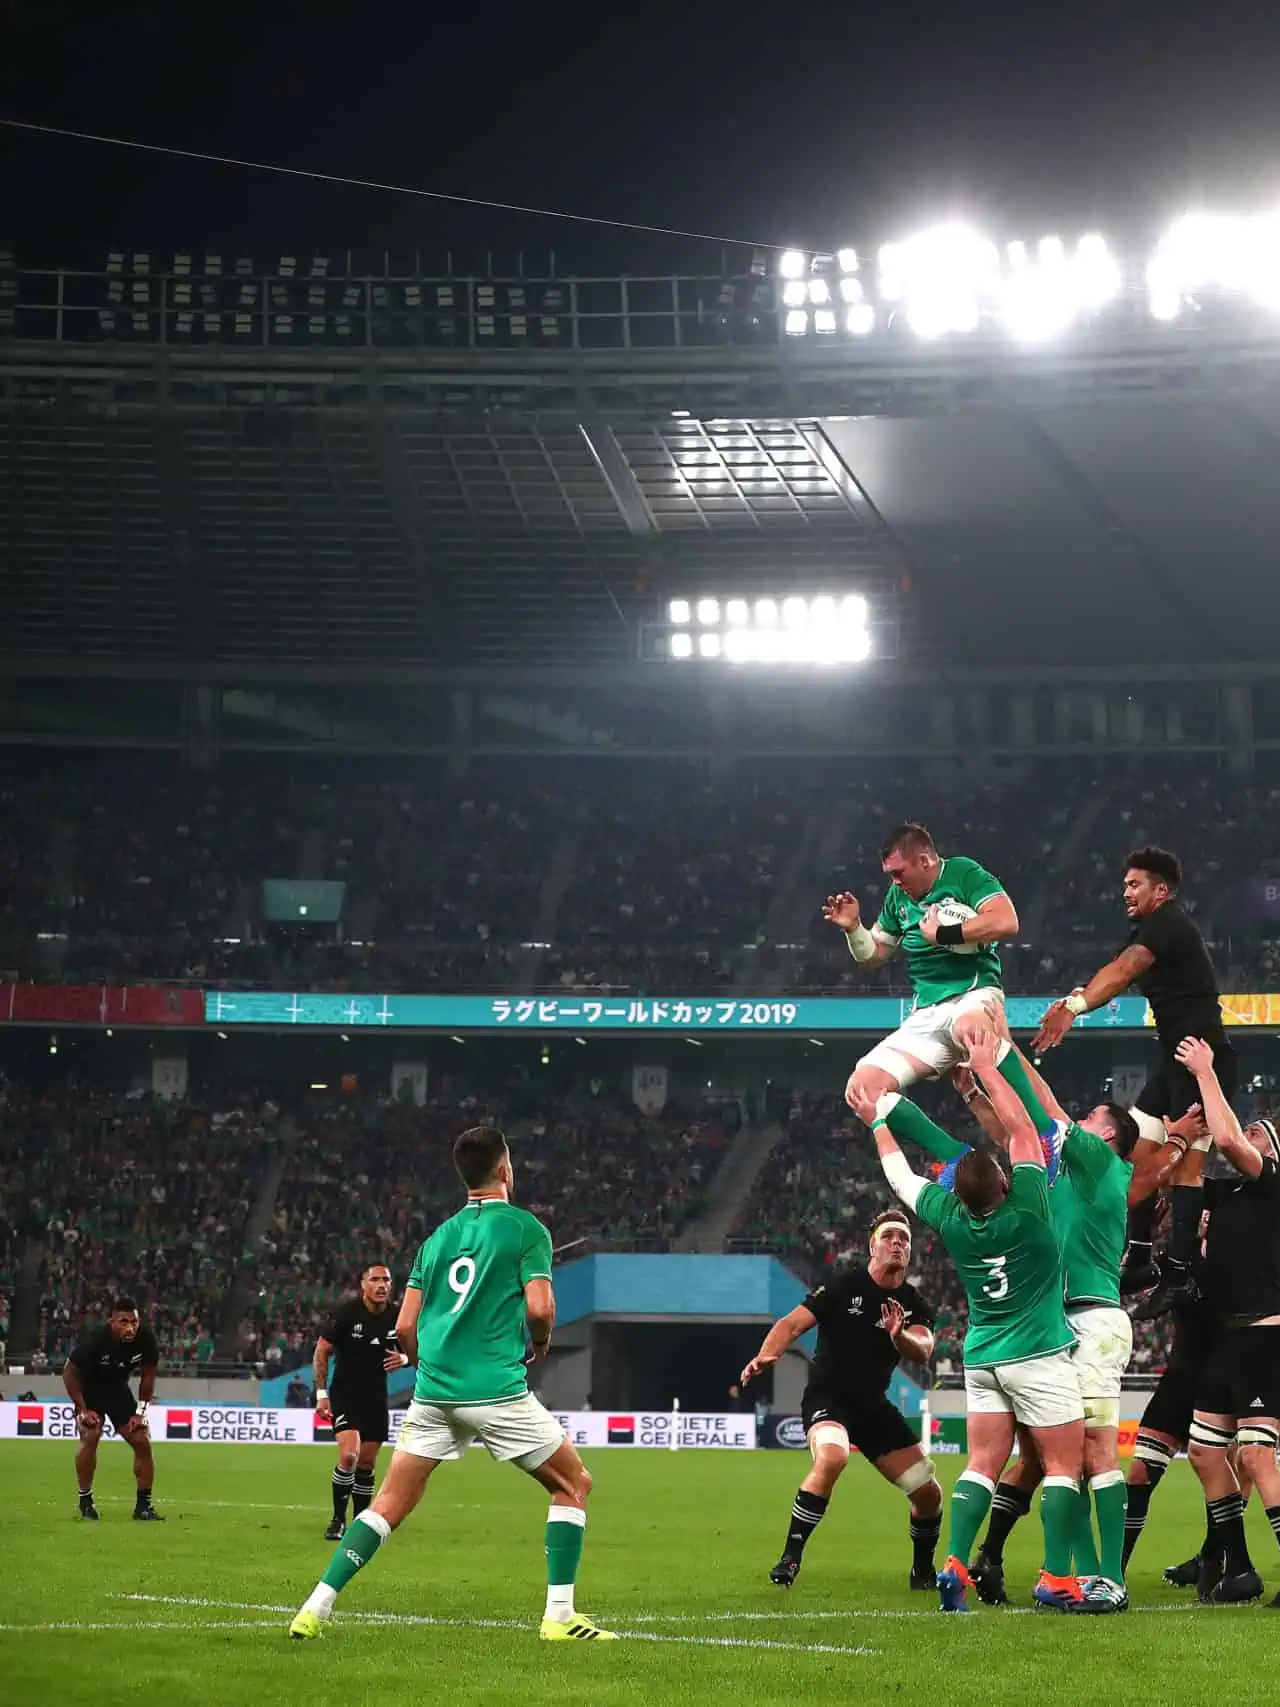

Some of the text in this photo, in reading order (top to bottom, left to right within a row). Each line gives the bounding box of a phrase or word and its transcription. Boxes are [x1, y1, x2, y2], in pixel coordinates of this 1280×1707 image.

[448, 1255, 476, 1315] 9
[981, 1255, 1009, 1299] 3
[198, 1410, 279, 1425] SOCIETE
[640, 1416, 727, 1431] SOIETE
[198, 1426, 297, 1442] GENERALE
